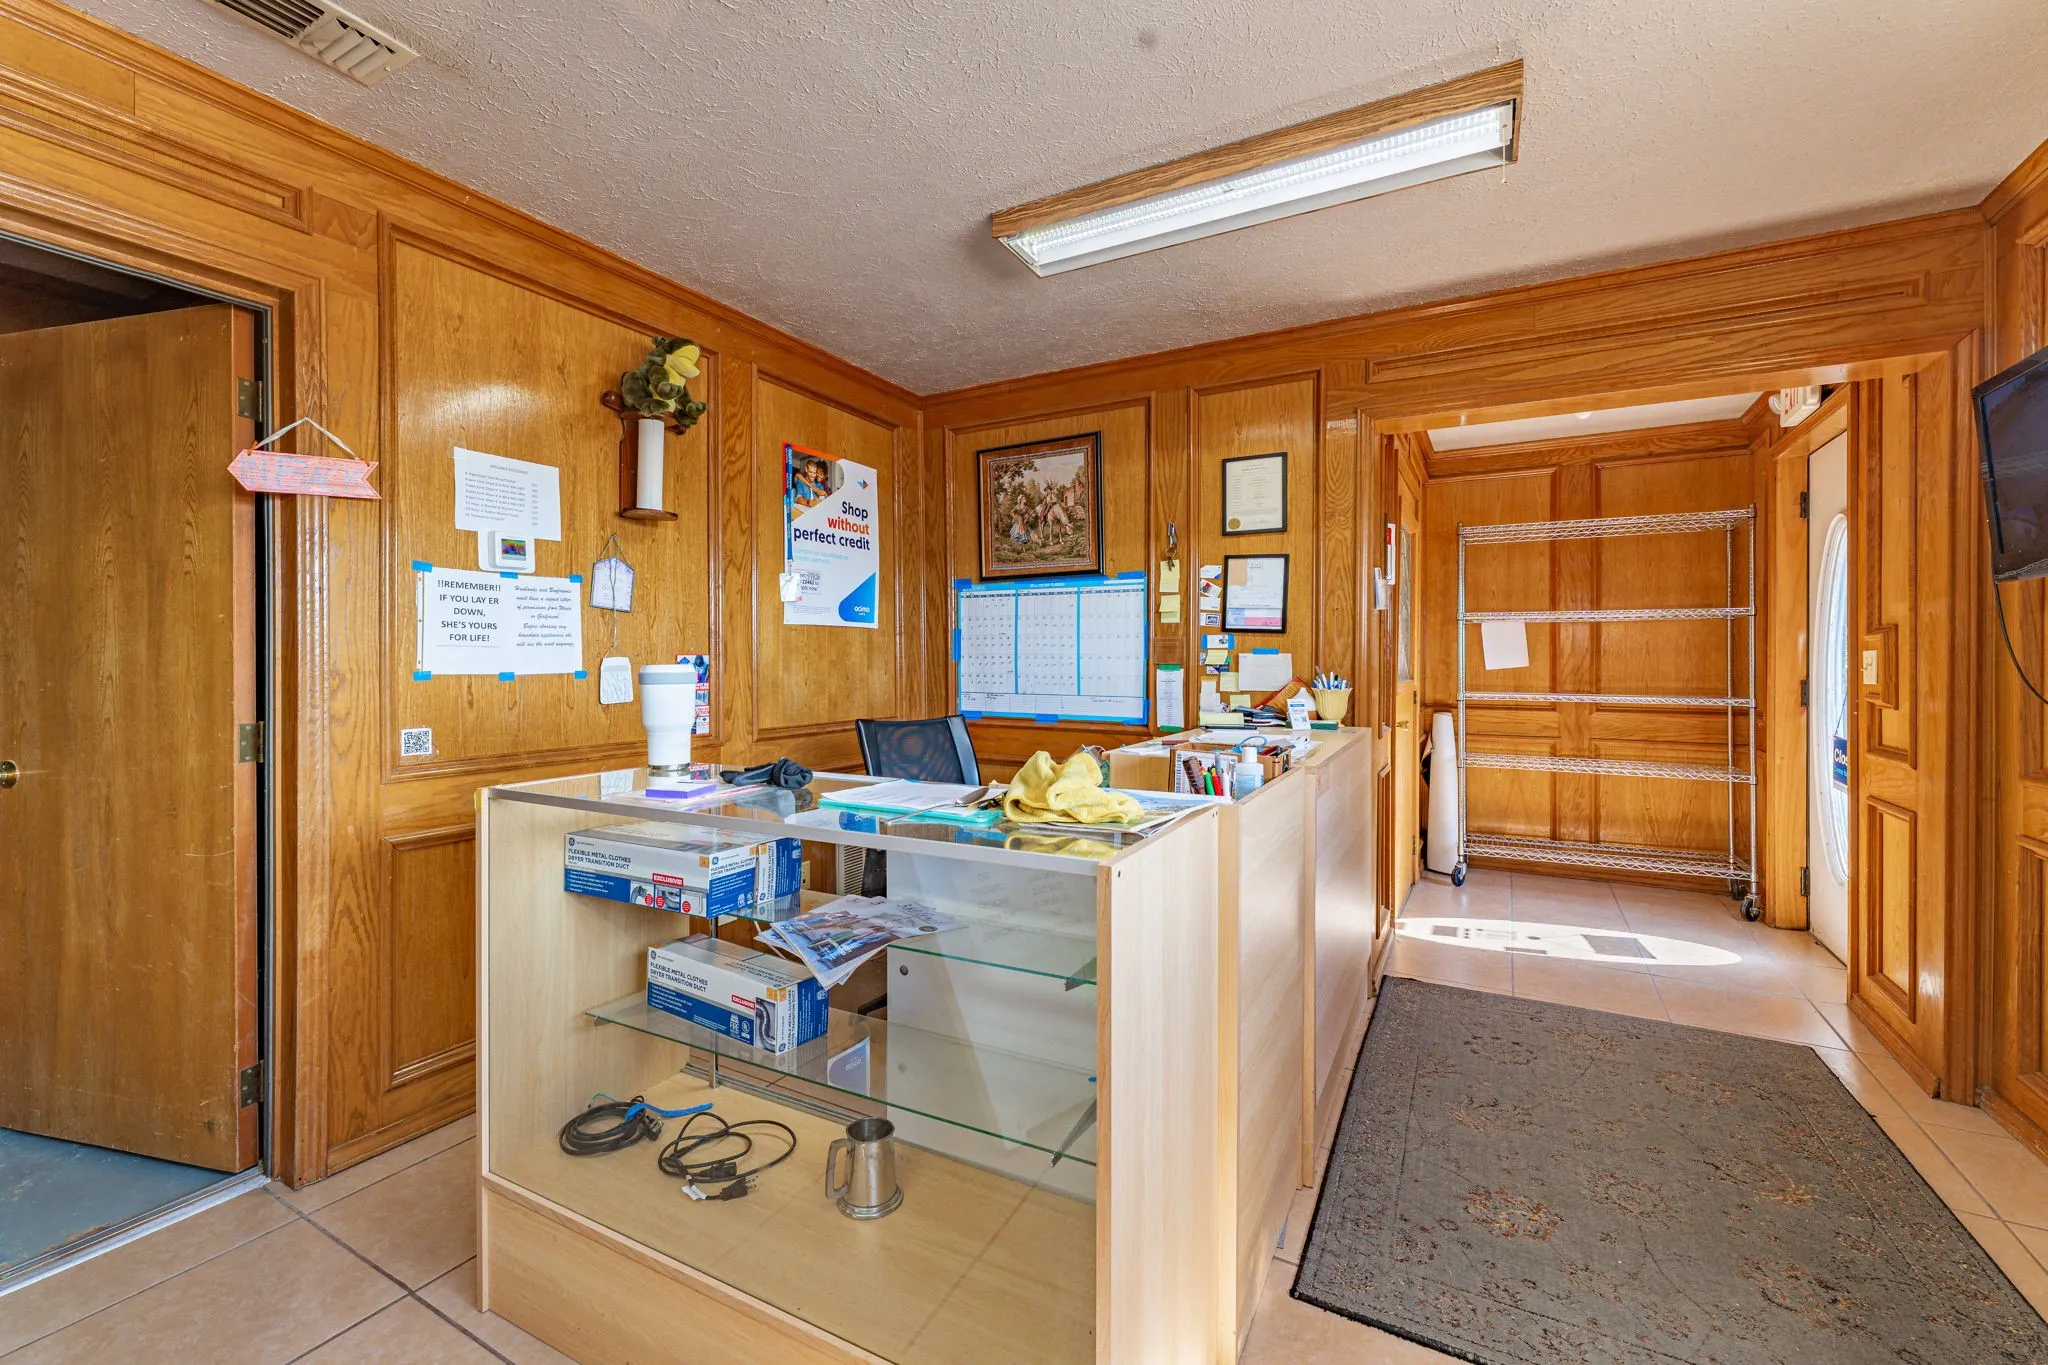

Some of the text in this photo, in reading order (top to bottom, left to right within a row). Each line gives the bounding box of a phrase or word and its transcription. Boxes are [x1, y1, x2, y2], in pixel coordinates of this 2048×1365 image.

[842, 501, 868, 520] Shop
[828, 516, 870, 535] without
[794, 528, 836, 545] perfect
[839, 536, 870, 550] credit
[438, 580, 501, 592] !!REMEMBER!!
[450, 595, 468, 603] YOU
[472, 596, 486, 604] LAY
[454, 607, 486, 617] DOWN,
[854, 605, 870, 613] acima
[441, 620, 498, 630] SHE'S YOURS
[450, 633, 490, 642] FOR LIFE!
[568, 848, 631, 863] FLEXIBLE METAL CLOTHES
[585, 858, 614, 867] TRANSITION
[650, 962, 708, 986] FLEXIBLE METAL CLOTHES
[650, 969, 706, 992] DRYER TRANSITION DUCT
